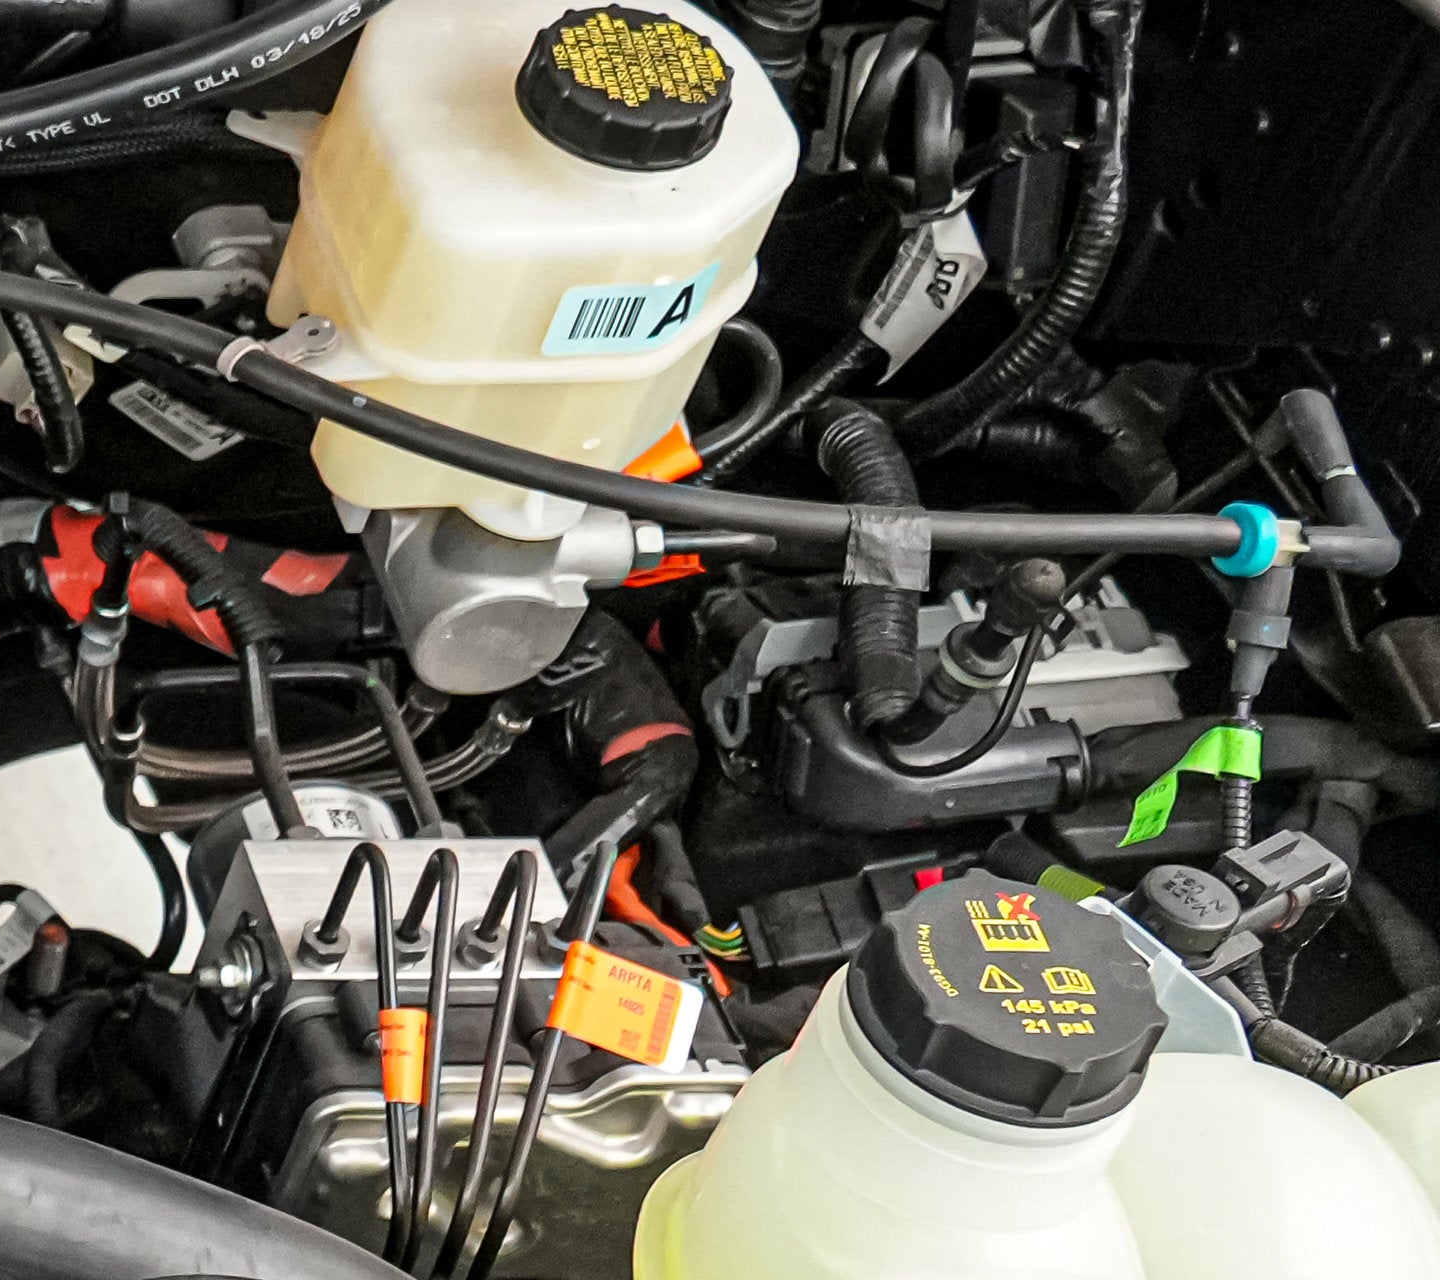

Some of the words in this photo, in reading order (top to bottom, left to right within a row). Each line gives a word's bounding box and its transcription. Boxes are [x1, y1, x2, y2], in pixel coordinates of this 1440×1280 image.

[25, 121, 76, 144] TYPE
[82, 111, 112, 127] UL
[142, 87, 182, 111] DOT
[195, 65, 240, 95] DLH
[250, 3, 363, 70] 03/18/25
[648, 283, 695, 340] A
[608, 965, 654, 994] ARPTA
[1001, 999, 1046, 1015] 145
[1048, 1000, 1098, 1016] kPa
[1021, 1019, 1053, 1035] 21
[1056, 1020, 1096, 1038] psi
